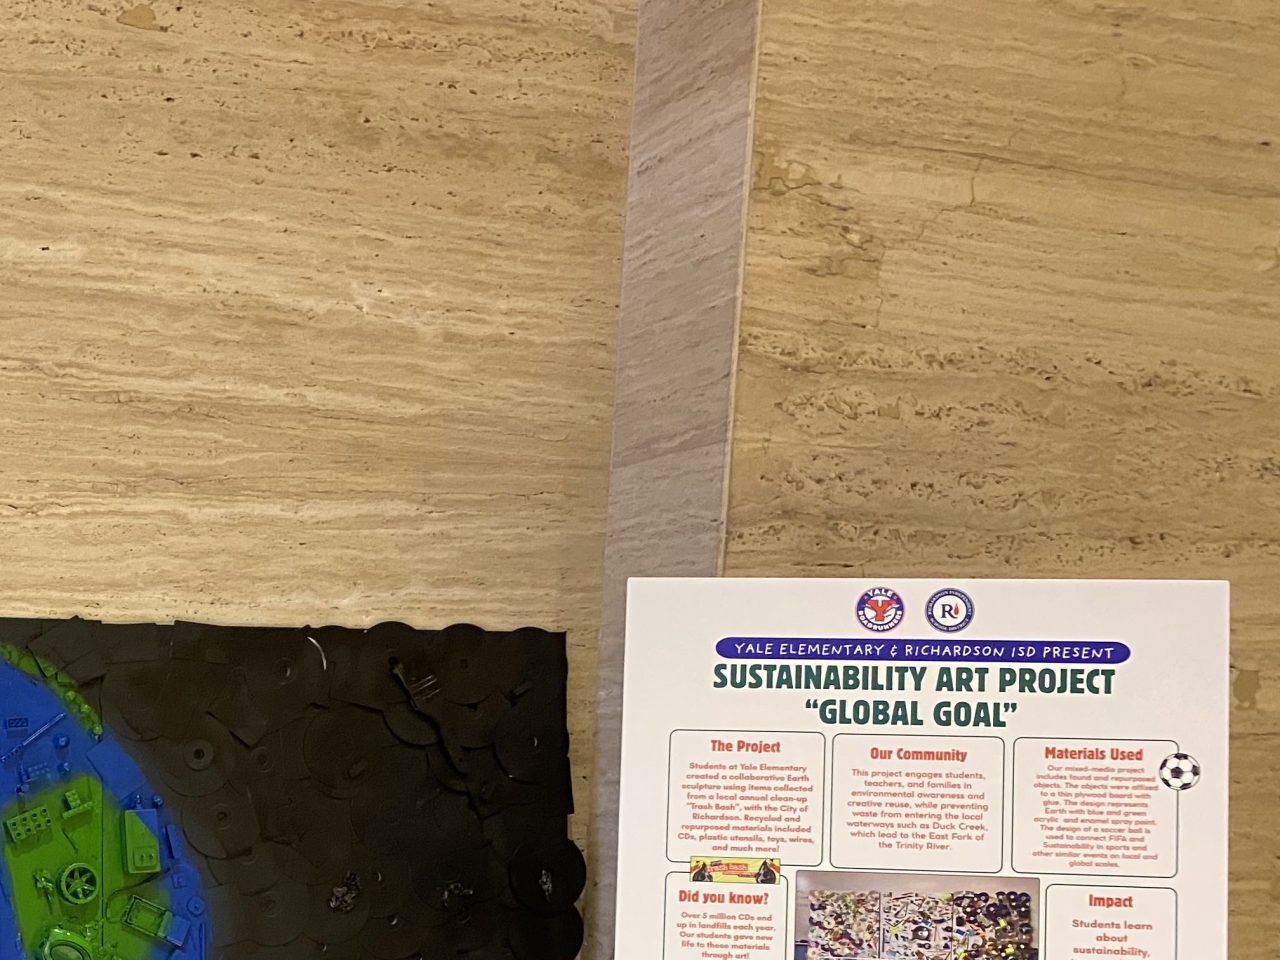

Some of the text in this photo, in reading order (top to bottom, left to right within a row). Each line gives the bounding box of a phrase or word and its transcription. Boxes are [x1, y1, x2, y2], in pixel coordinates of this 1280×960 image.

[868, 588, 894, 597] YALE
[858, 610, 903, 631] ROADRUNNERS
[735, 643, 1114, 659] YALE ELEMENTARY & RICHARDSON ISD PRESENT
[713, 664, 1115, 694] SUSTAINABILITY ART PROJECT
[711, 740, 780, 754] The Project
[870, 747, 967, 762] Our Community
[1045, 747, 1143, 761] Materials Used
[852, 768, 869, 776] This
[945, 771, 985, 779] students,
[864, 780, 904, 788] teachers,
[927, 781, 961, 789] families
[851, 790, 914, 798] environmental
[967, 792, 985, 800] and
[914, 801, 938, 809] while
[940, 803, 988, 812] preventing
[880, 810, 902, 818] from
[904, 812, 942, 821] entering
[944, 812, 959, 820] the
[846, 821, 894, 829] waterways
[932, 822, 955, 830] Duck
[958, 822, 988, 831] Creek,
[928, 832, 948, 840] East
[896, 841, 924, 850] Trinity
[926, 842, 952, 850] River.
[679, 890, 769, 904] Did you know?
[1089, 894, 1133, 908] Impact
[1072, 919, 1152, 930] Students learn
[1096, 933, 1128, 942] about
[1073, 947, 1150, 959] sustainability,
